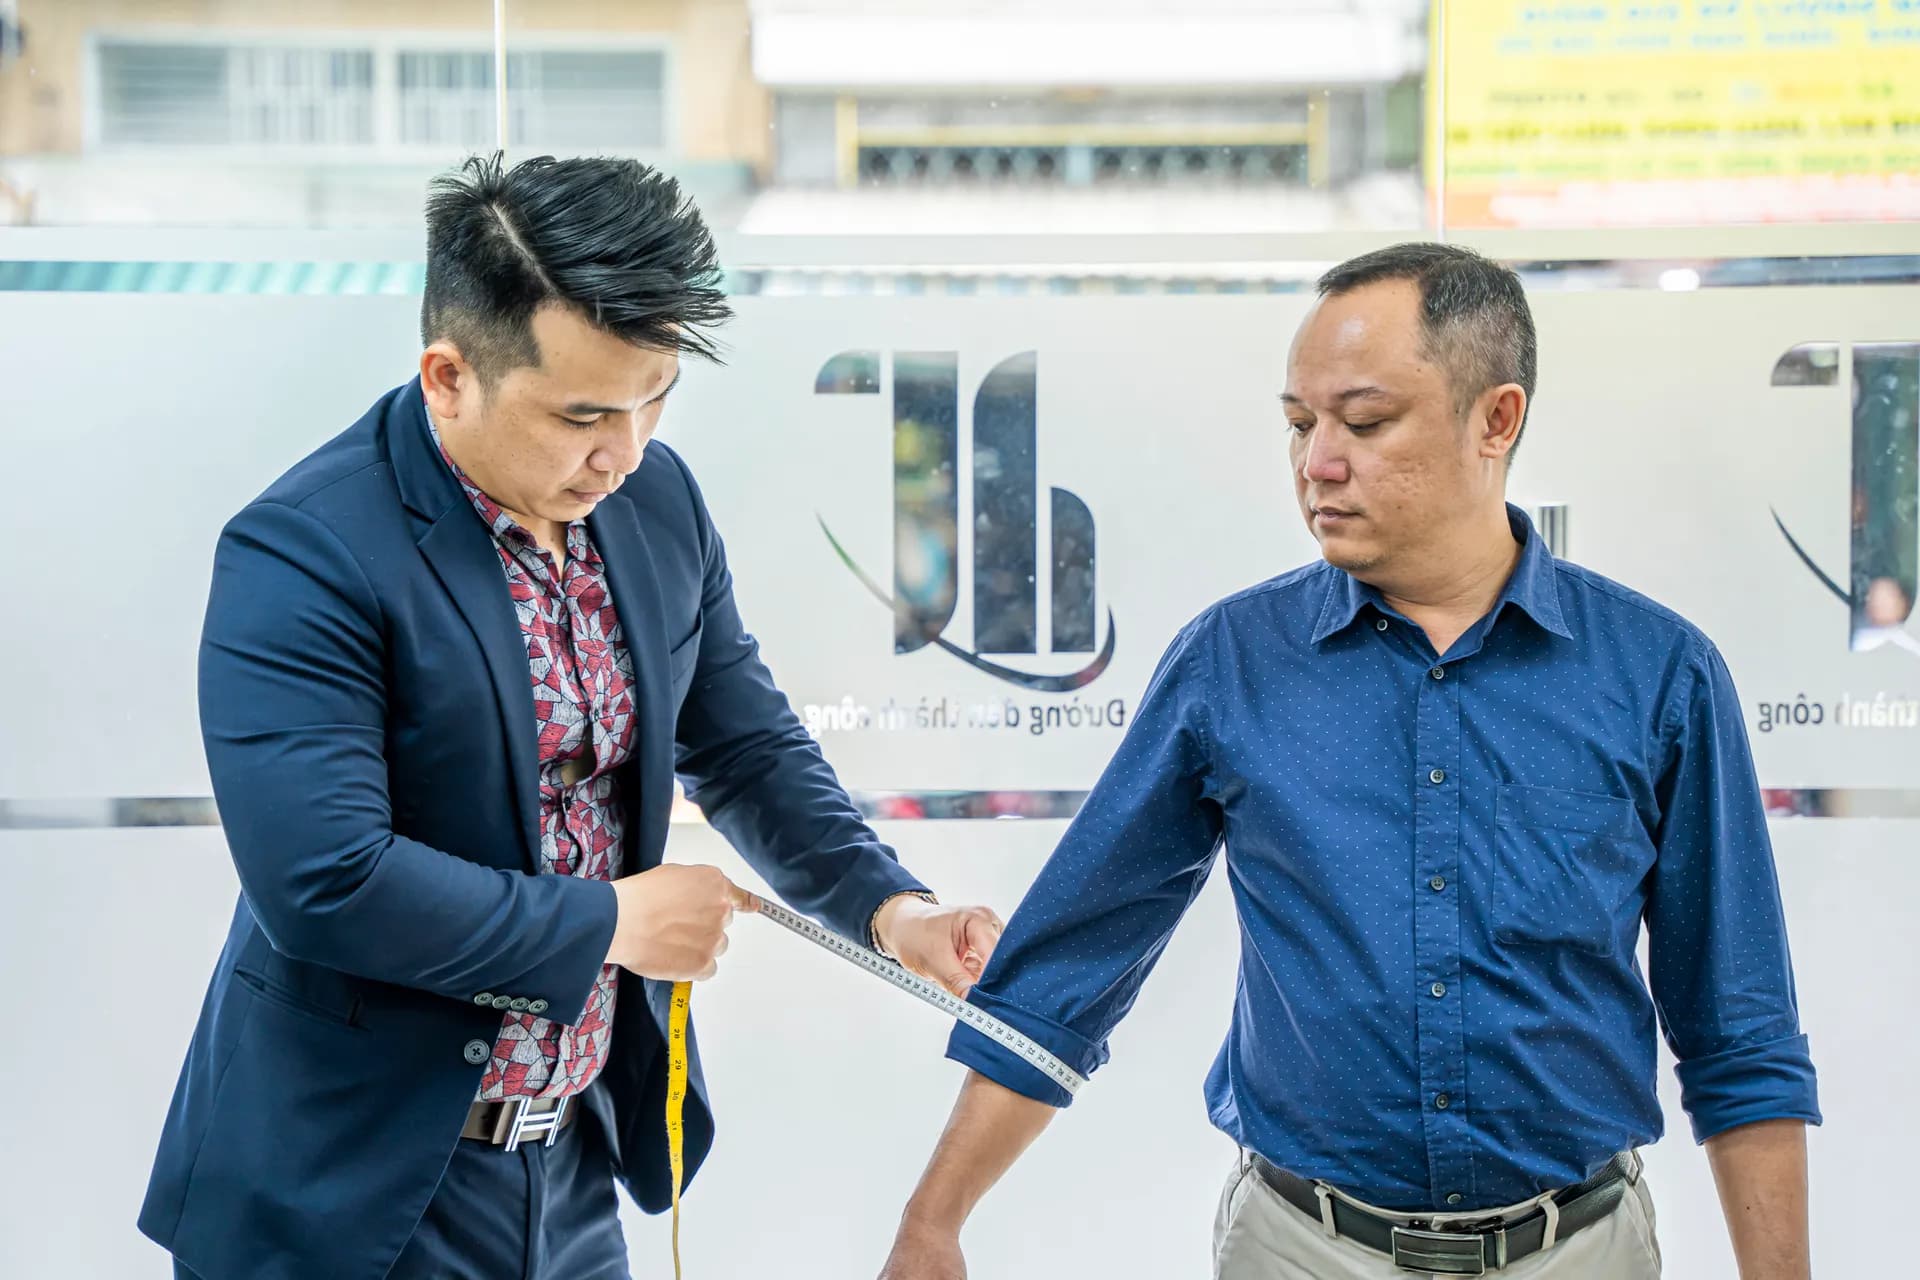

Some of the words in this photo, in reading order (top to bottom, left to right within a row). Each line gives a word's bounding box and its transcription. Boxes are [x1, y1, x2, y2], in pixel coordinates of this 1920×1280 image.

[676, 998, 684, 1008] 27
[674, 1028, 680, 1039] 28
[676, 1060, 682, 1070] 29
